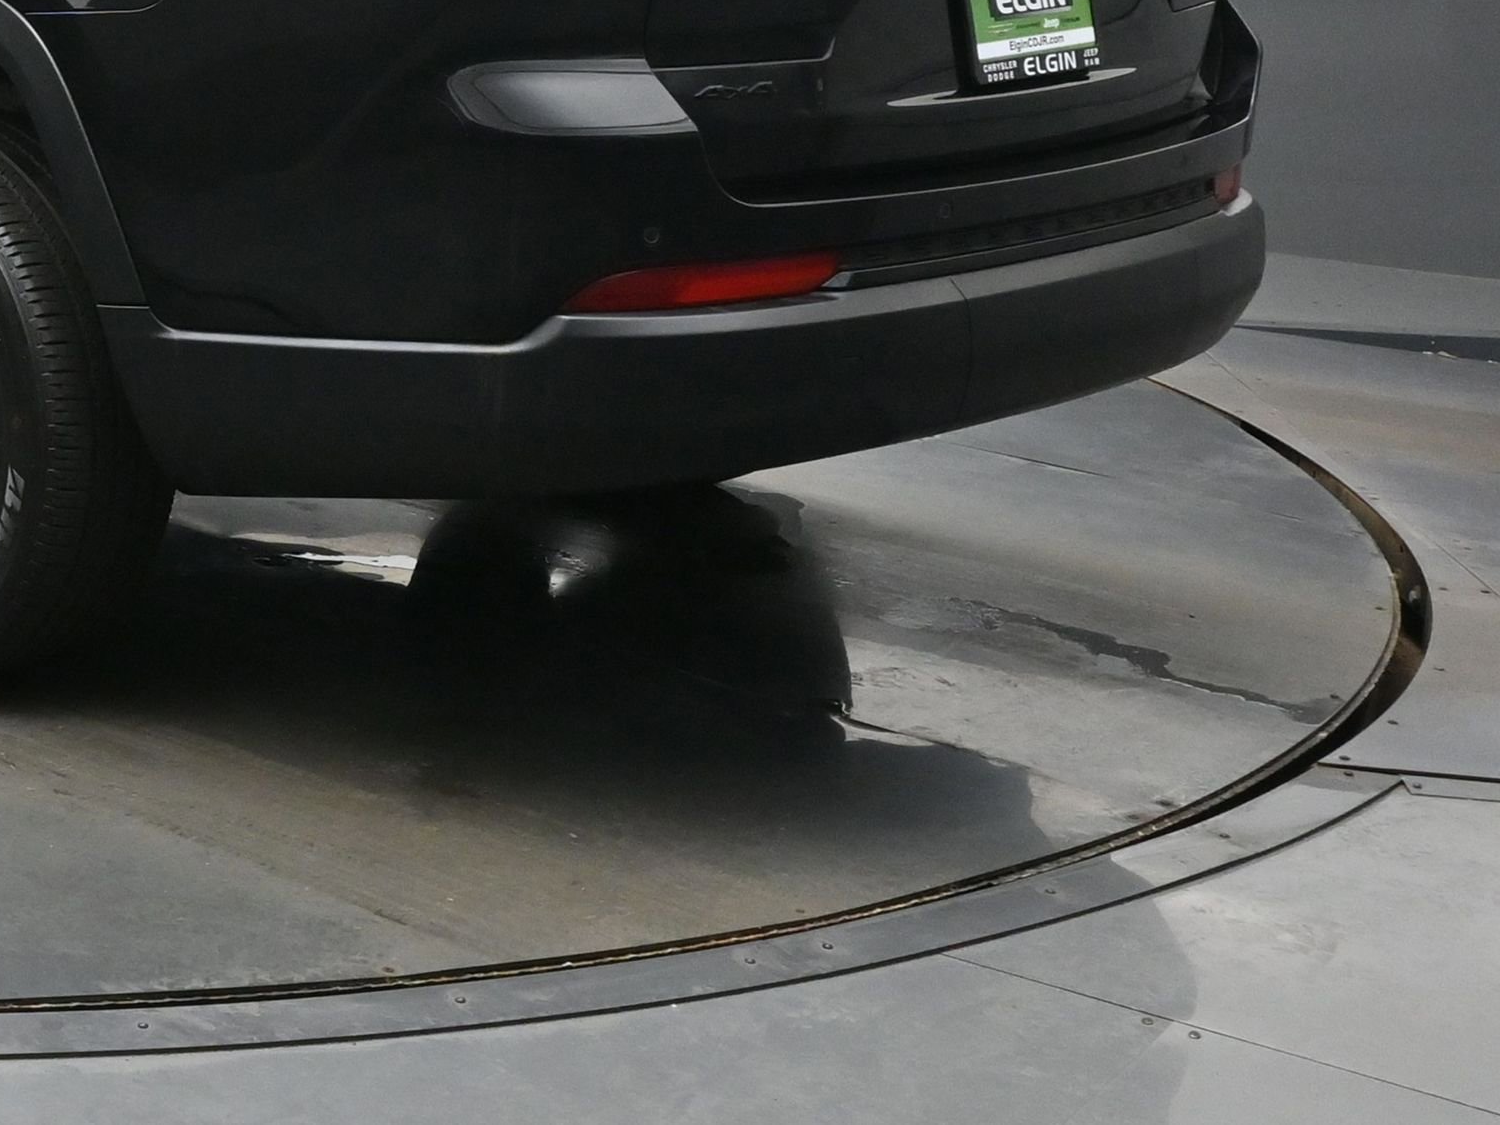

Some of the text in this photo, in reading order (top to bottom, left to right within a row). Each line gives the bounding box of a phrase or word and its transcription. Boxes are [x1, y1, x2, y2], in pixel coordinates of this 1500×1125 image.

[1009, 34, 1065, 52] ElginCDJR.com
[983, 60, 1018, 73] CHRYSLER
[1023, 50, 1077, 76] ELGIN
[987, 70, 1015, 83] DODGE
